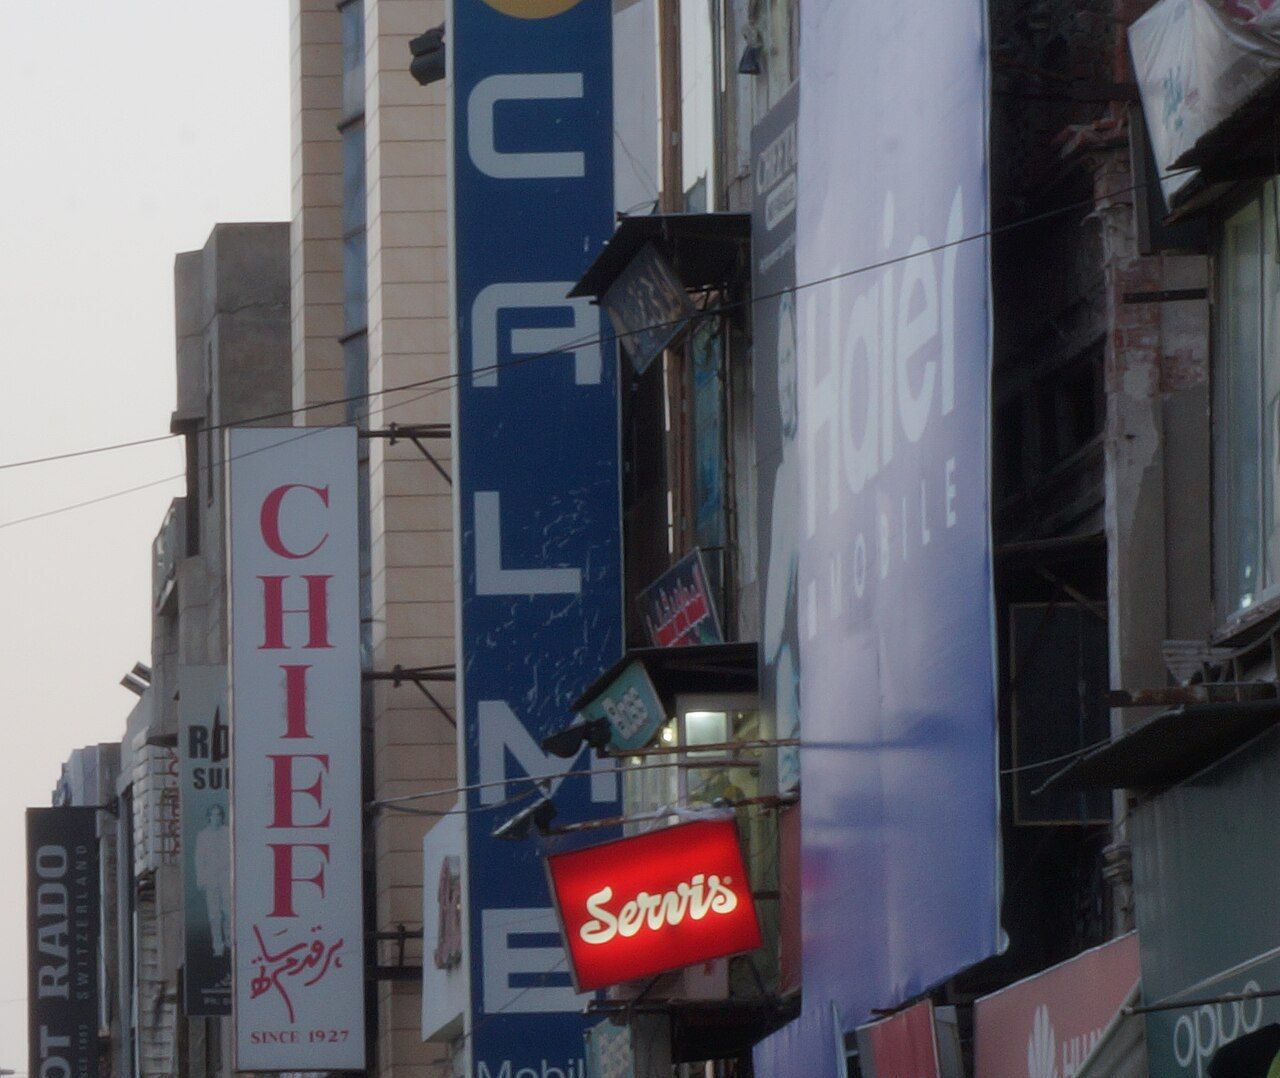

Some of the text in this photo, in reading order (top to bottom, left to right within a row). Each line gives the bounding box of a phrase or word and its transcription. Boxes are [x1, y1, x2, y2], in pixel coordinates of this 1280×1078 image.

[254, 482, 336, 918] CHIEF
[35, 843, 71, 1000] RADO
[76, 844, 89, 1001] SWITZERLAND
[579, 873, 739, 946] Servis
[251, 1029, 350, 1045] SINCE 1927
